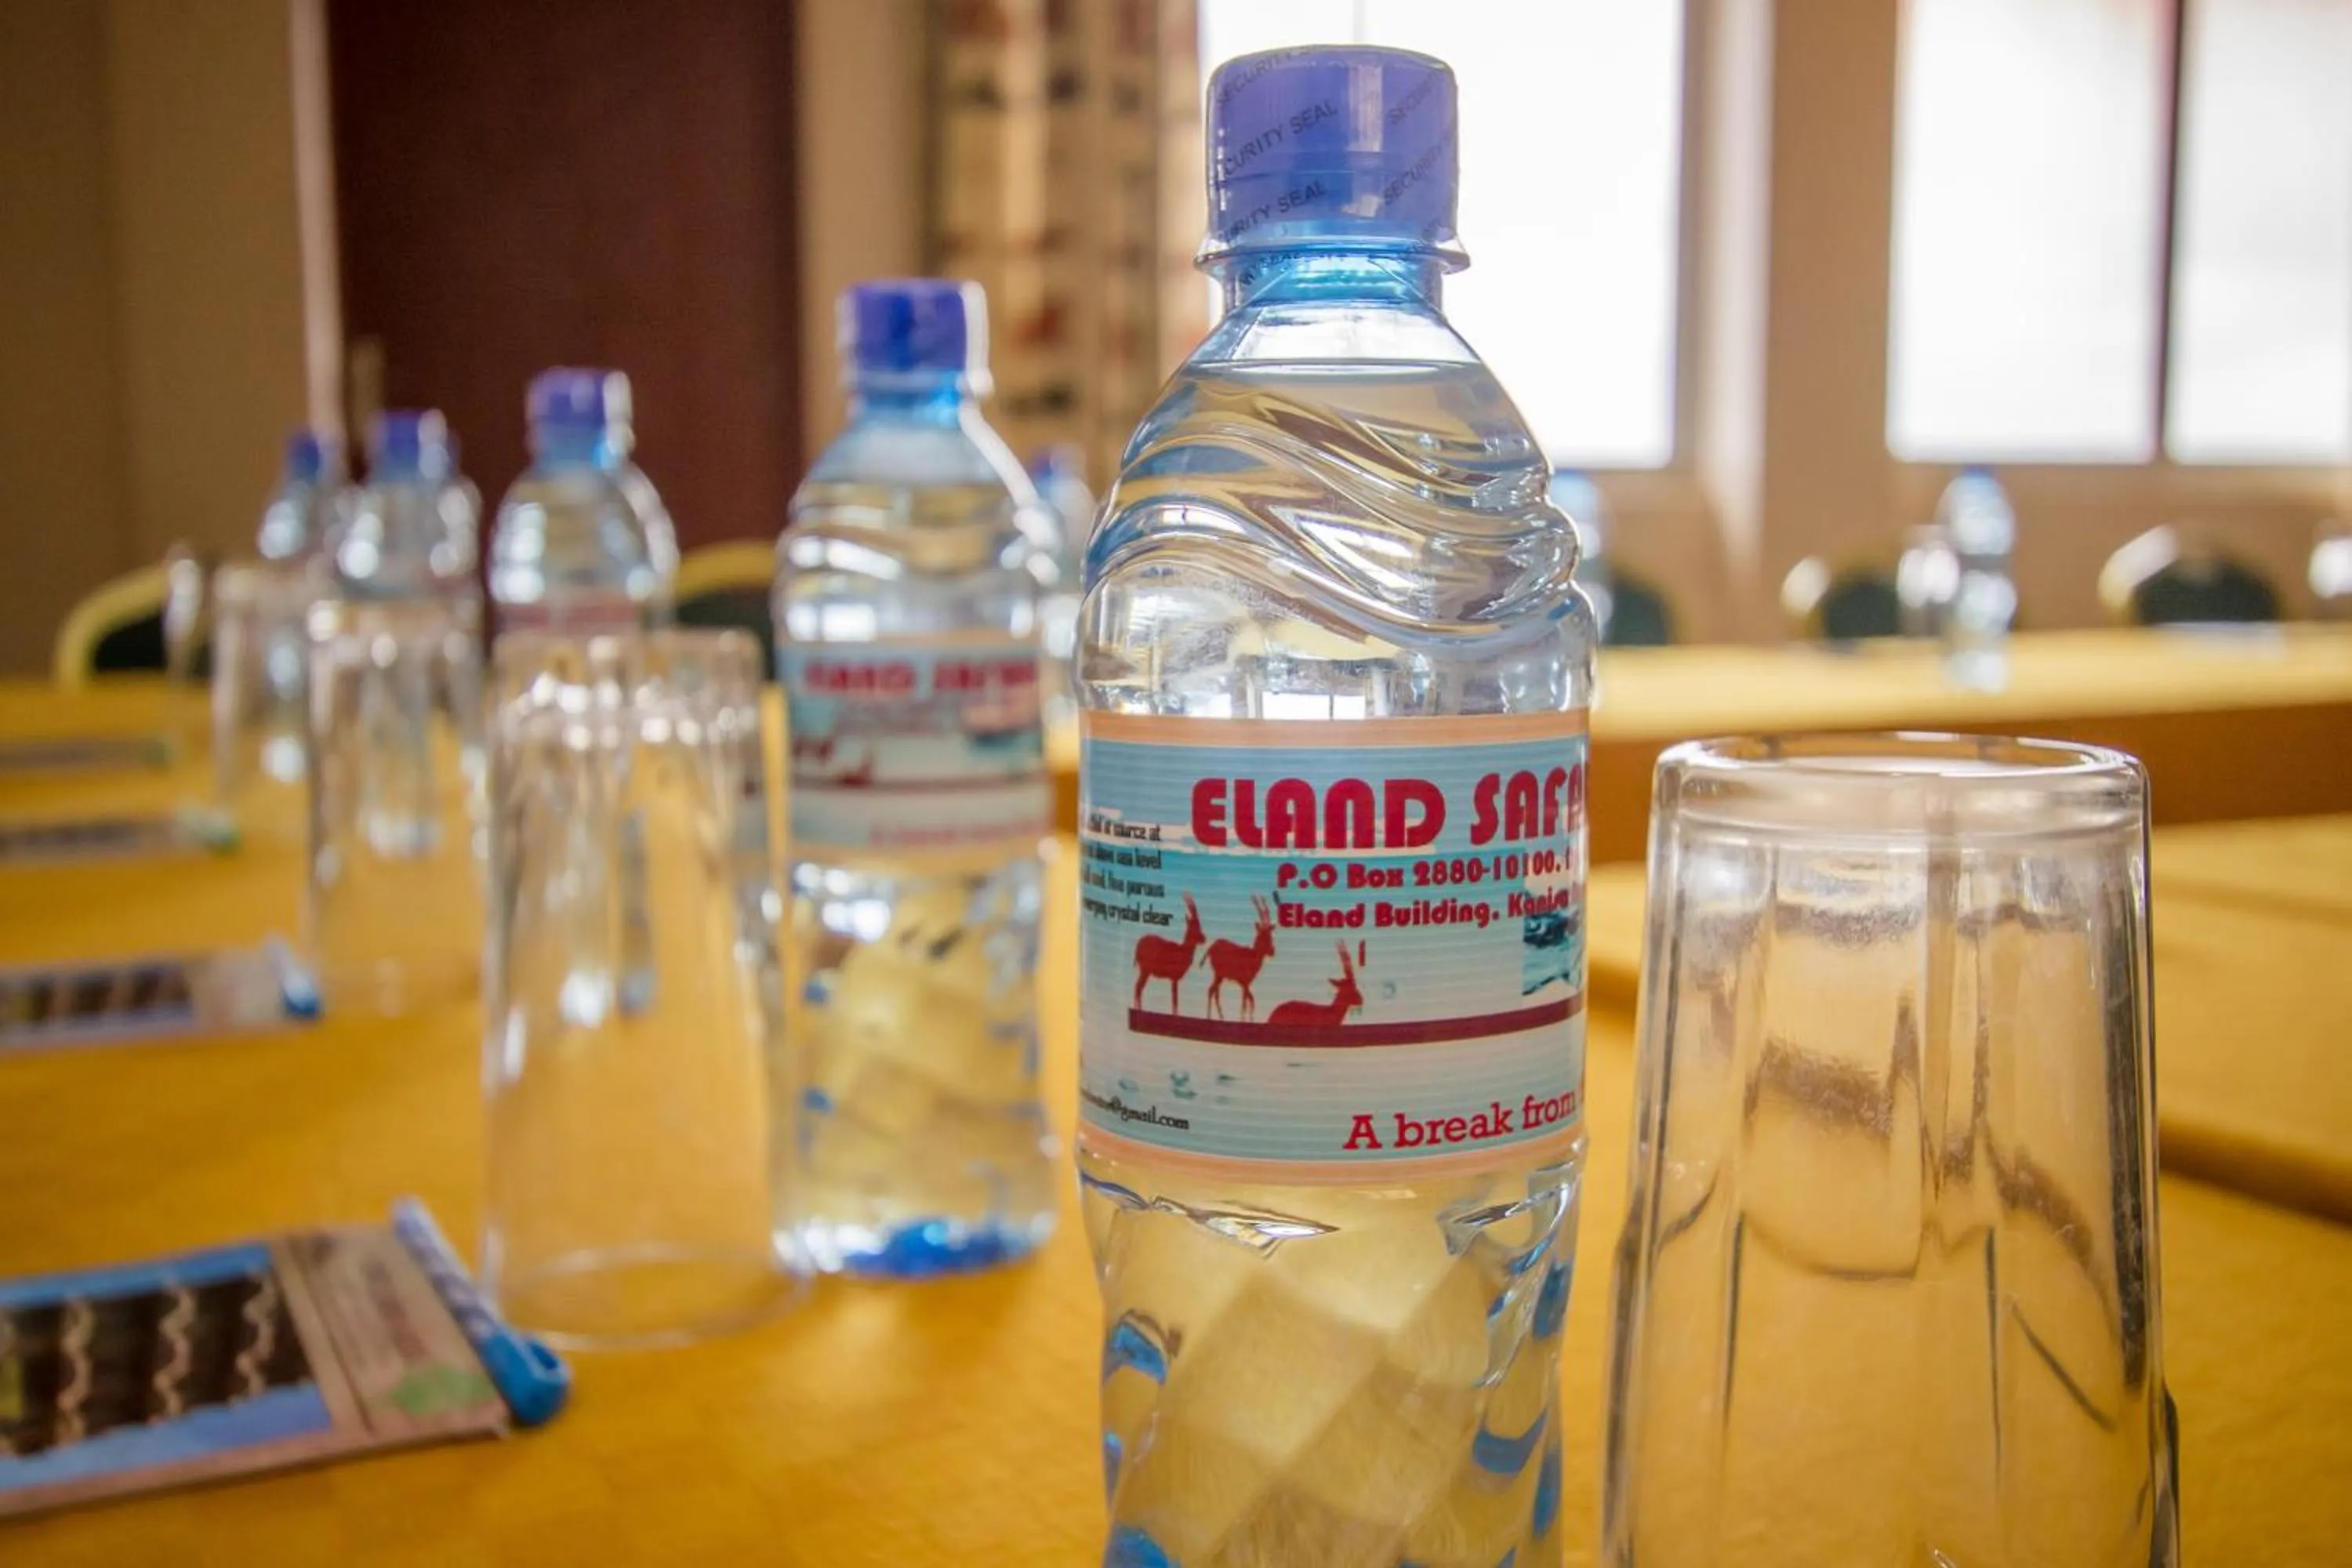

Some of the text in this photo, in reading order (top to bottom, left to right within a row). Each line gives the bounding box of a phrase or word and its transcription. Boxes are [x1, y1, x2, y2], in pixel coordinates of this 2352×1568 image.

[1290, 99, 1338, 135] SEAL
[1277, 179, 1327, 214] SEAL
[1191, 777, 1446, 850] ELAND
[1134, 846, 1162, 869] level
[1277, 862, 1338, 889] P.O
[1346, 863, 1404, 889] Box
[1142, 902, 1174, 927] clear
[1277, 902, 1366, 928] Eland
[1341, 1093, 1577, 1150] A break from
